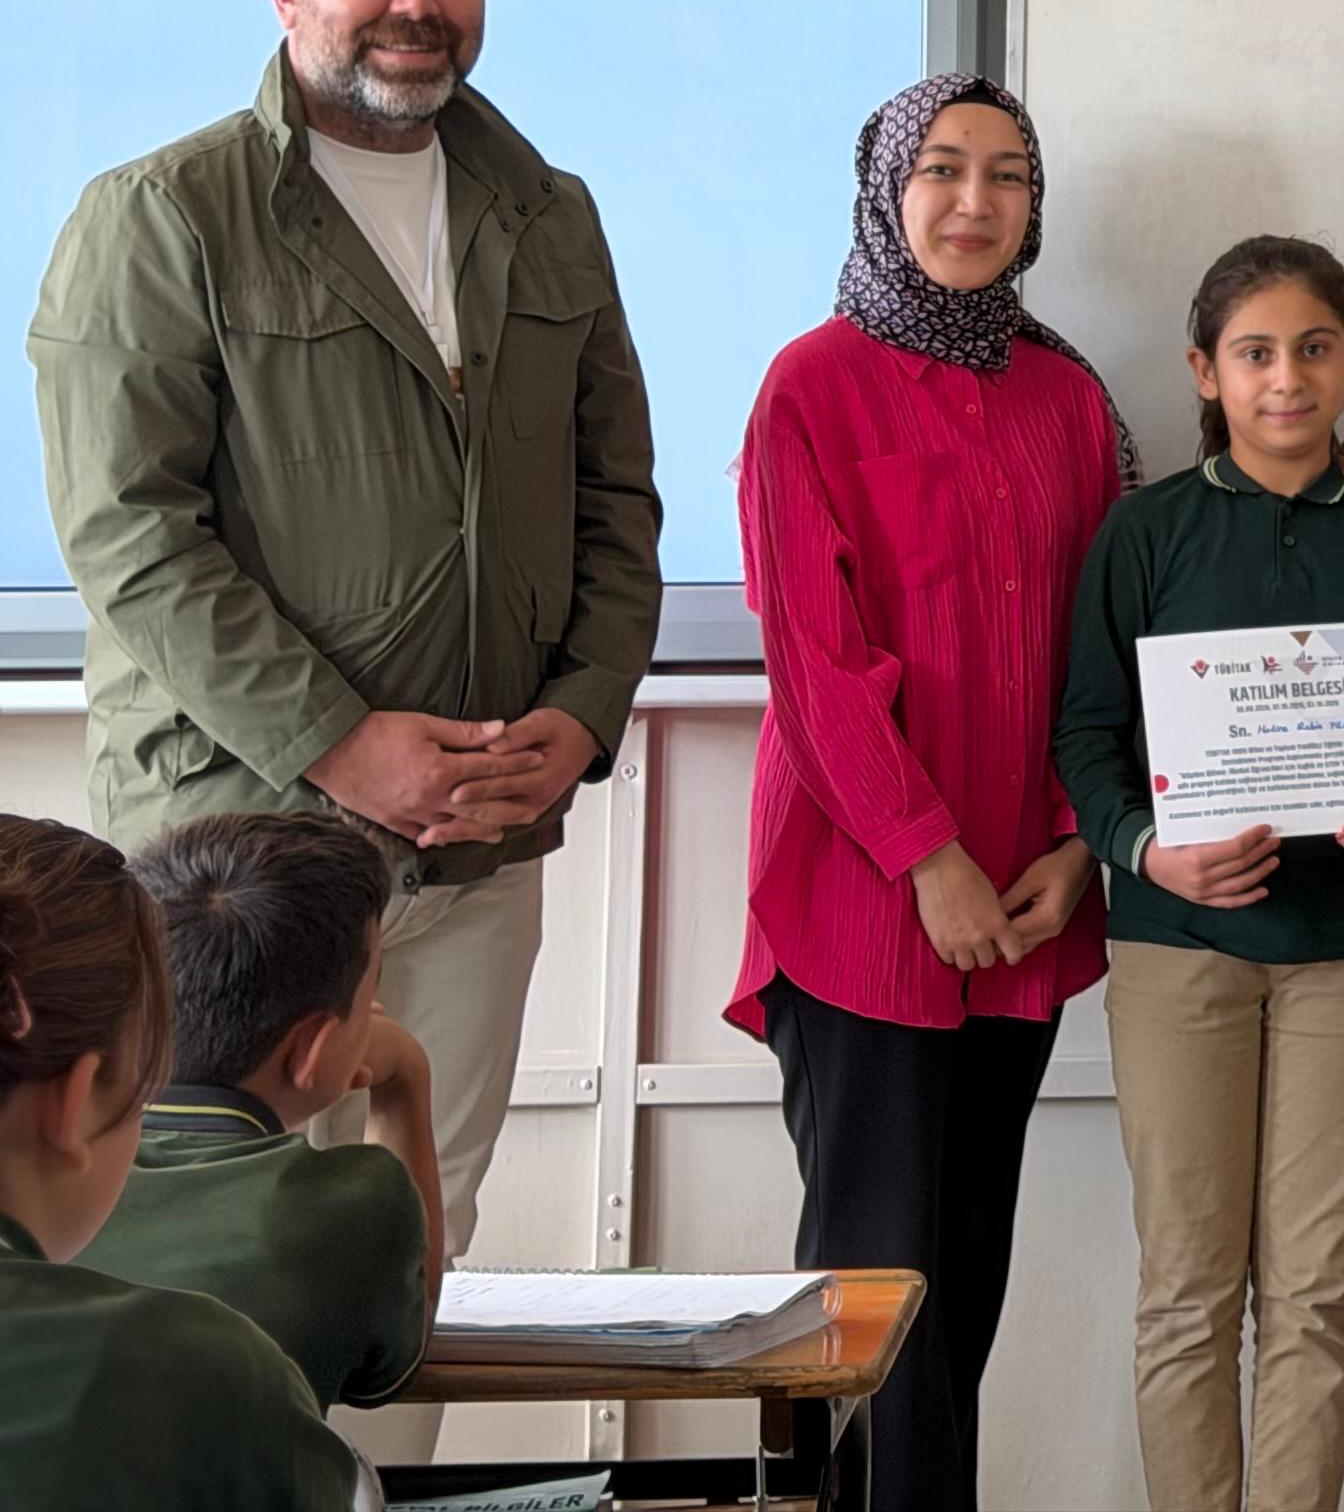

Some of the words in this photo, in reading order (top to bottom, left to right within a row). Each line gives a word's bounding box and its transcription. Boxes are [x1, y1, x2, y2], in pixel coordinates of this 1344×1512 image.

[1214, 662, 1252, 676] TÜBİTAK
[1229, 684, 1288, 702] KATILIM
[1228, 724, 1252, 739] Sn.
